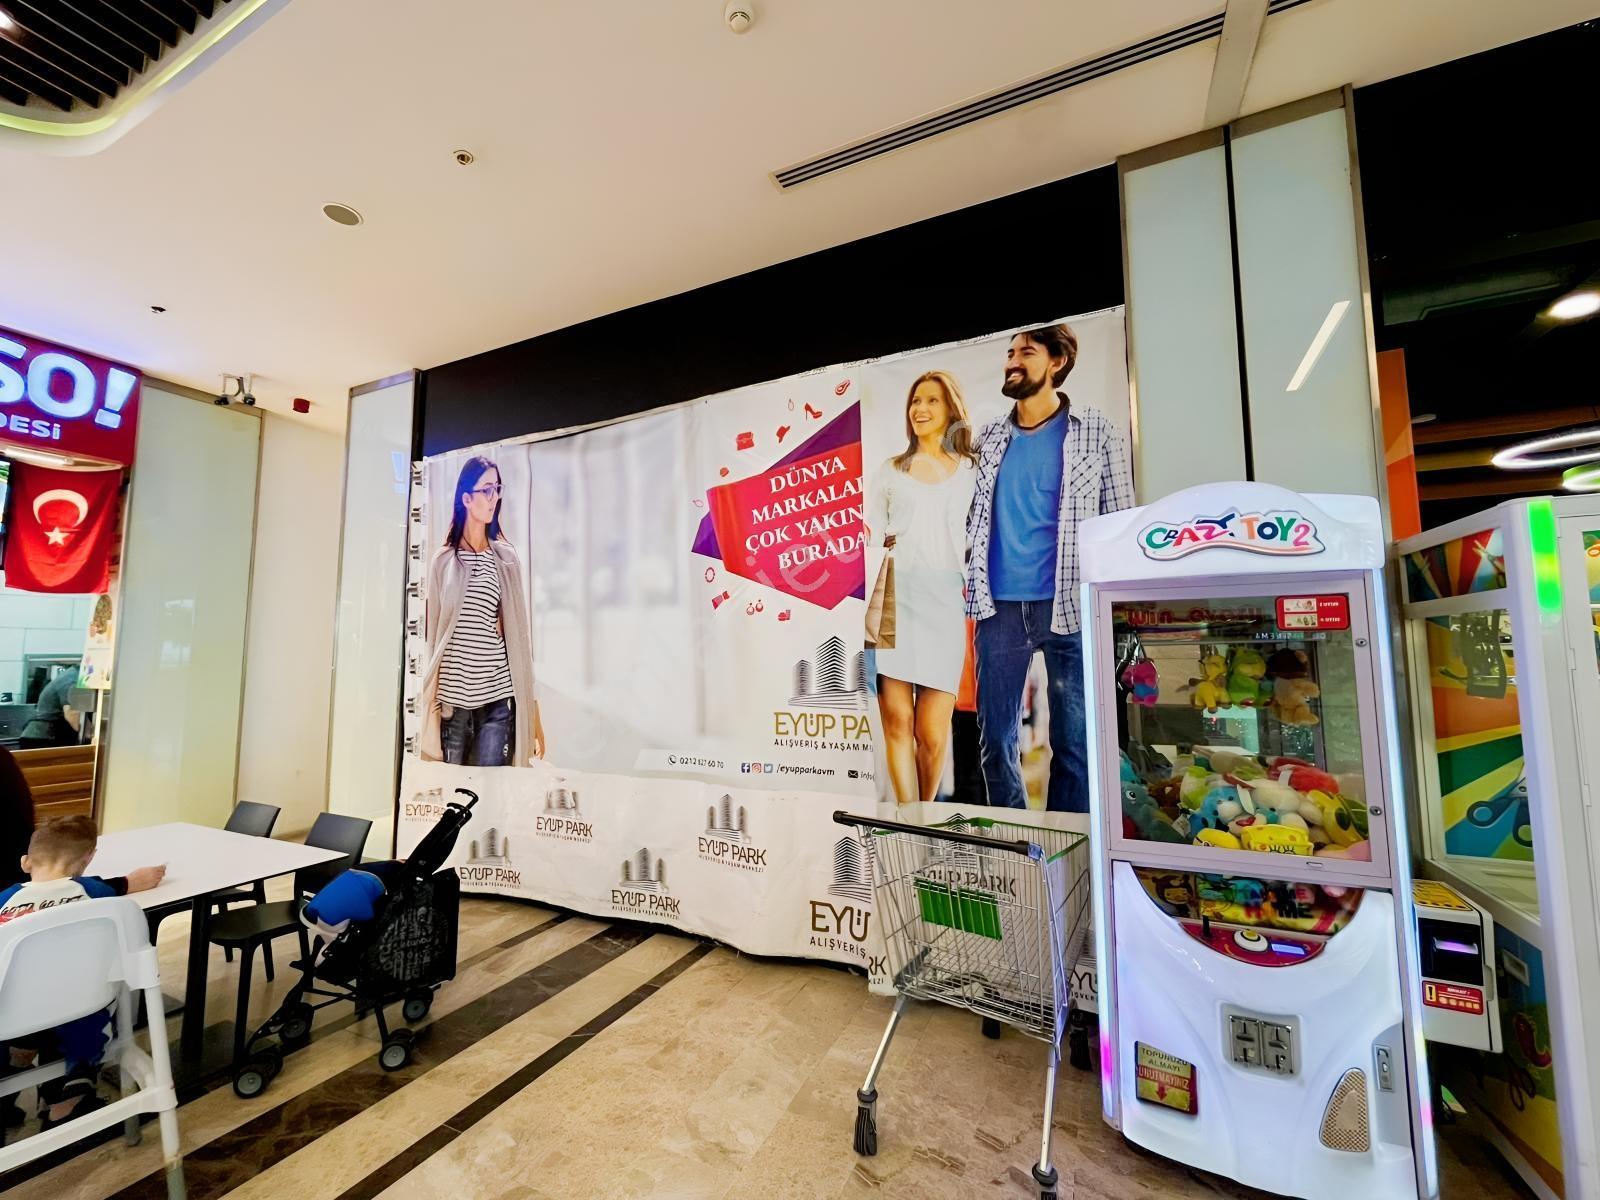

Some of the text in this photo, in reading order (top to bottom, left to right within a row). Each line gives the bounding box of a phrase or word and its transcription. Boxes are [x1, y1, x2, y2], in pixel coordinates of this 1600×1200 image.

[769, 456, 847, 494] DÜNYA
[745, 525, 791, 555] ÇOK
[1145, 513, 1310, 549] CRAZY TOY2
[778, 531, 866, 571] BURADA
[774, 712, 836, 738] EYÜP
[829, 742, 860, 752] YAŞAM
[565, 820, 593, 838] PARK
[731, 843, 767, 866] PARK
[495, 868, 521, 885] PARK
[648, 894, 681, 915] PARK
[810, 936, 866, 960] ALIŞVERİŞ
